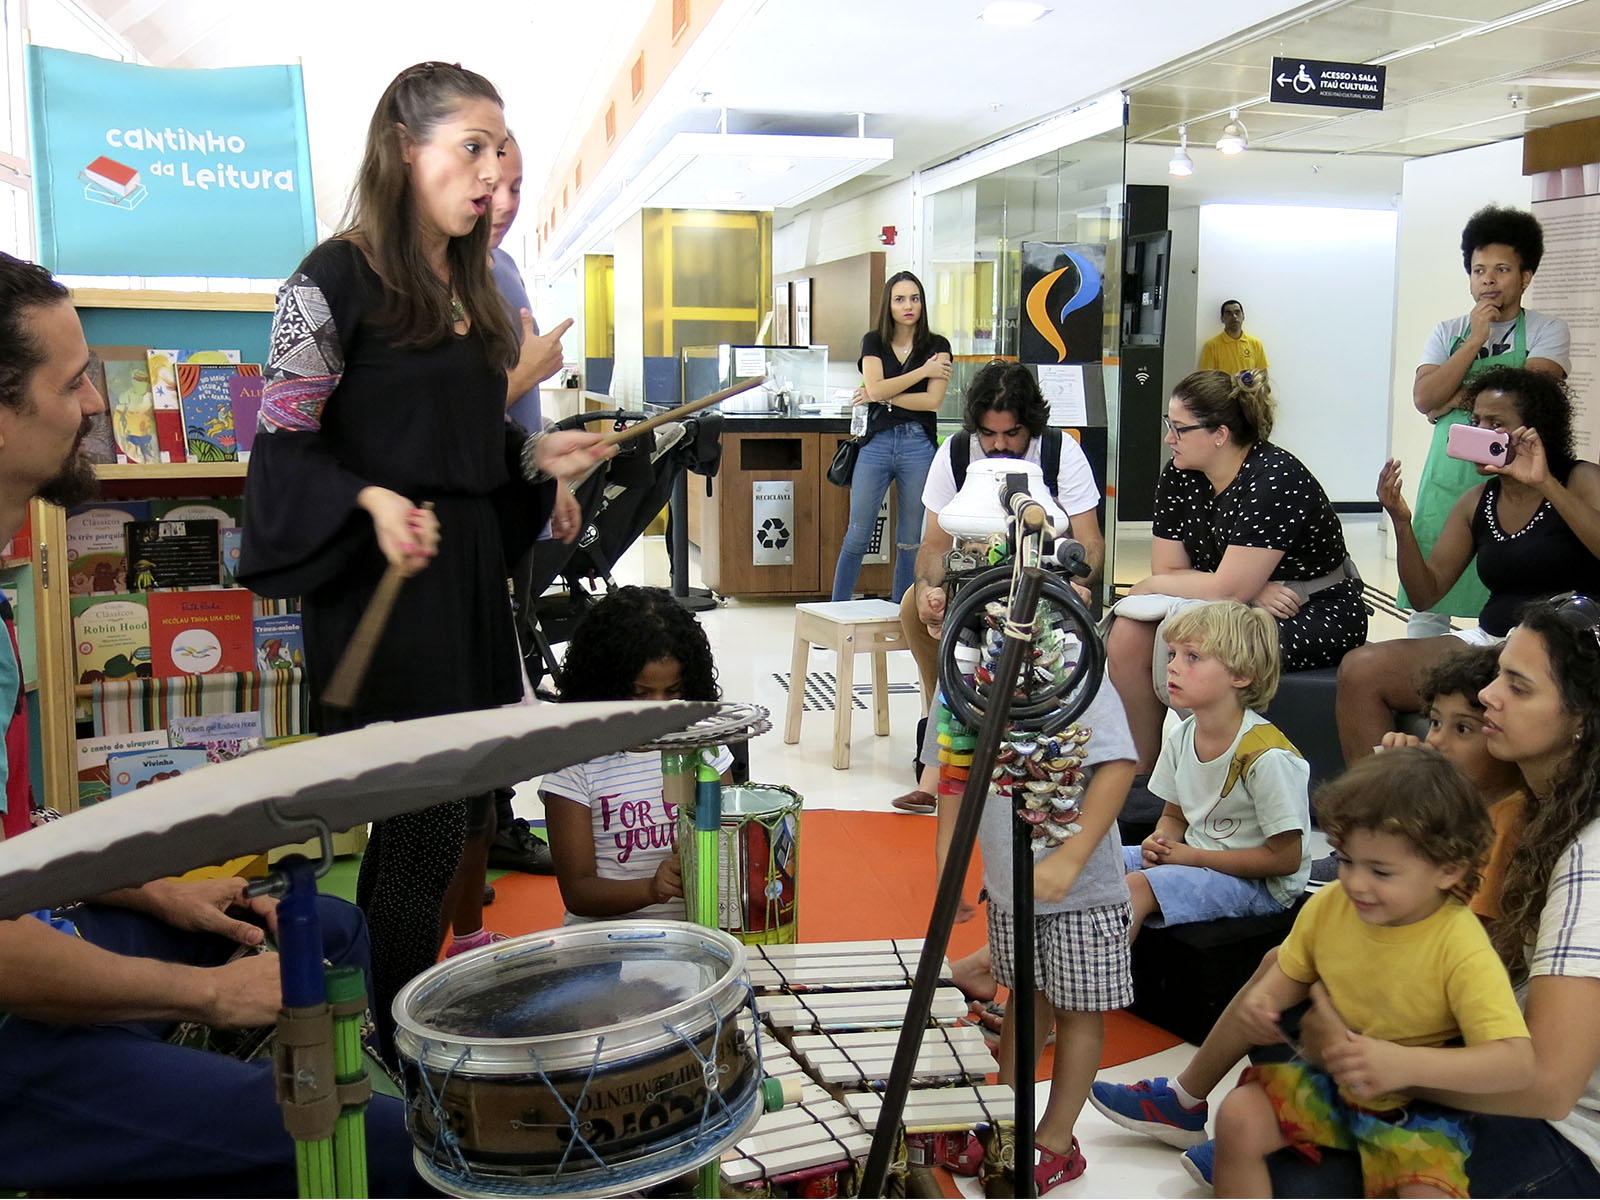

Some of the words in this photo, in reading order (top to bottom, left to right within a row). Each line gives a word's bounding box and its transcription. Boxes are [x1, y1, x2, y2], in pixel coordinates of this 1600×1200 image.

[1320, 71, 1351, 80] ACESSO
[1358, 74, 1377, 82] SALA
[1320, 80, 1338, 89] ITAÚ
[1339, 82, 1379, 92] CULTURAL
[149, 161, 175, 177] da
[181, 162, 295, 192] Leitura
[83, 624, 116, 635] Robin
[120, 621, 148, 631] Hood
[597, 792, 657, 832] FOR
